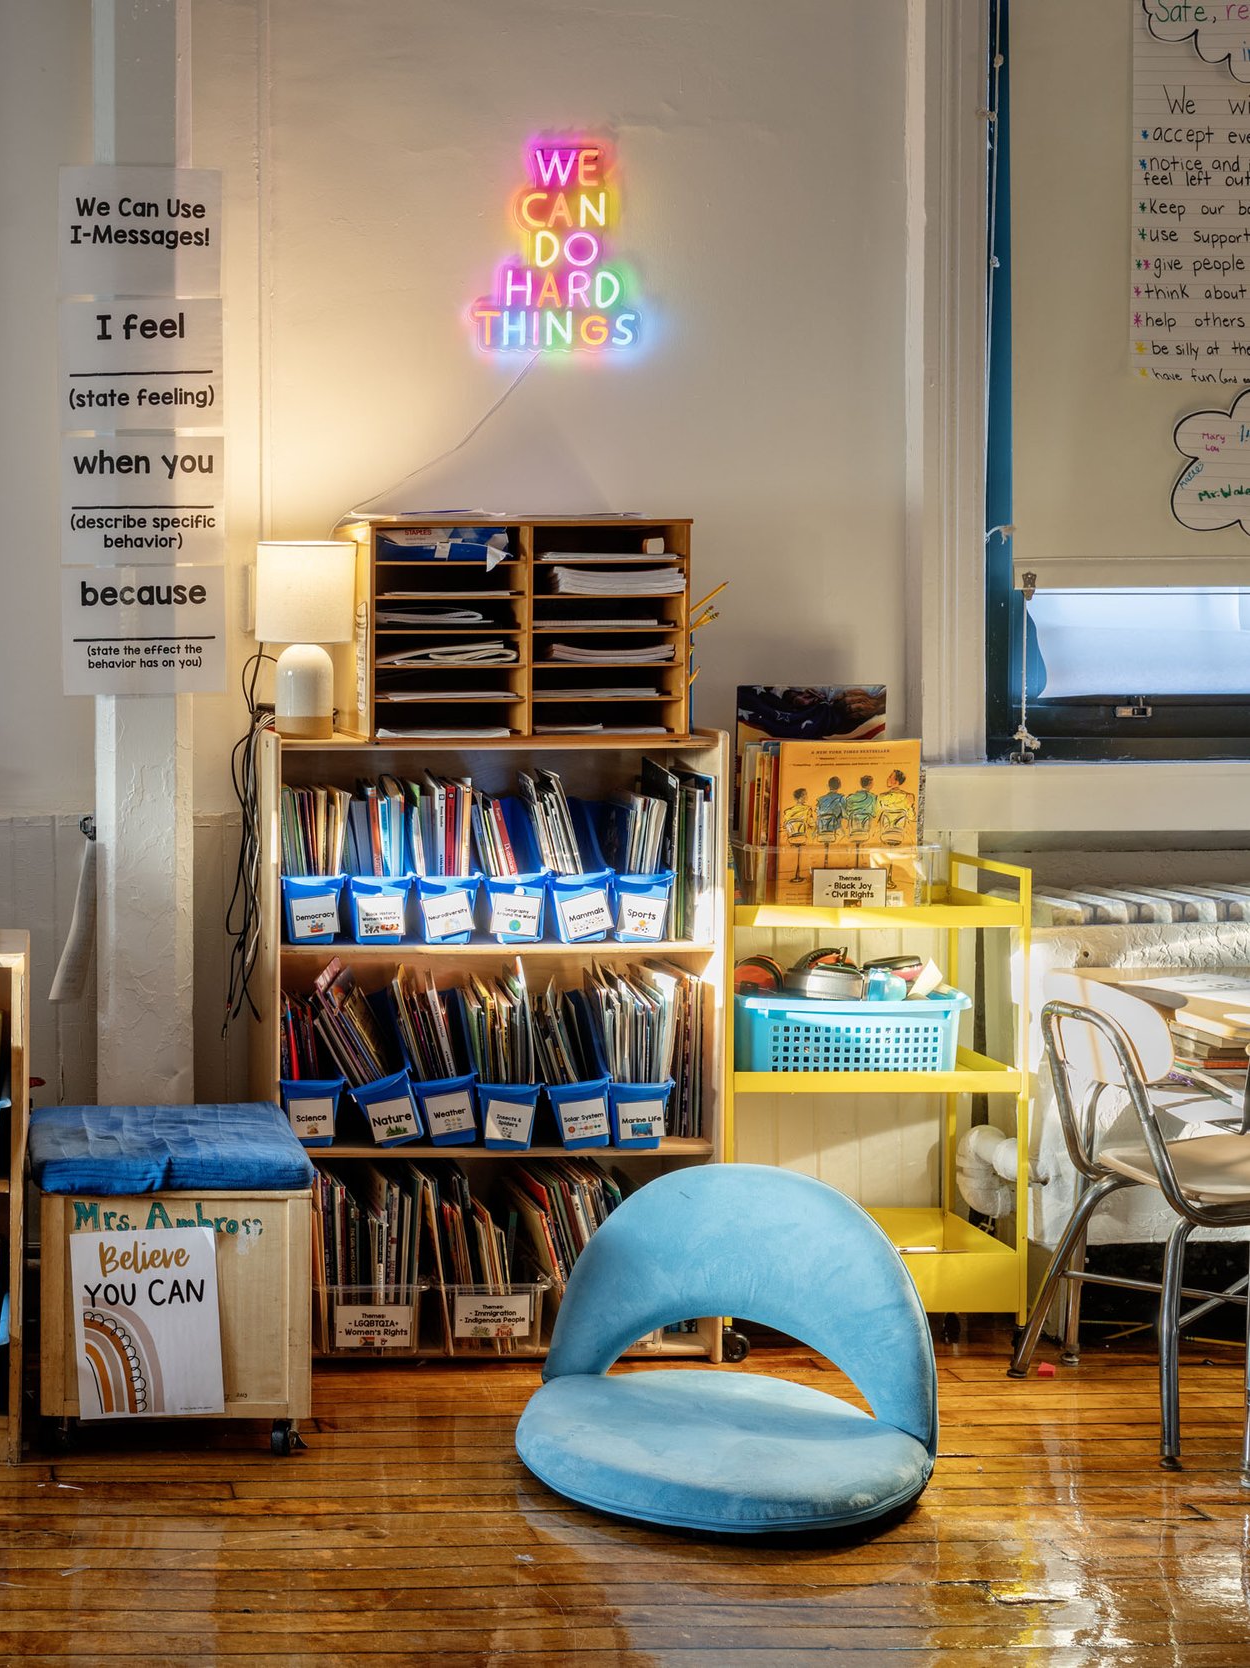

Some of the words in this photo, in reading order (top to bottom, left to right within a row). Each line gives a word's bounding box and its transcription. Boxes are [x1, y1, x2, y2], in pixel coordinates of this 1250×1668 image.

[1163, 84, 1196, 115] We
[1153, 125, 1214, 152] accept
[535, 149, 599, 186] WE
[1150, 155, 1203, 171] notice
[1211, 155, 1240, 172] and
[1144, 171, 1173, 186] feel
[1186, 170, 1212, 186] left
[75, 197, 111, 217] We
[118, 197, 159, 218] Can
[166, 199, 206, 219] Use
[521, 192, 606, 228] CAN
[1201, 204, 1225, 215] our
[70, 224, 210, 250] I-Messages!
[1150, 229, 1179, 242] use
[535, 230, 599, 268] DO
[1154, 258, 1183, 278] give
[1193, 253, 1245, 277] people
[506, 269, 620, 308] HARD
[1144, 283, 1190, 300] think
[1204, 284, 1247, 300] about
[96, 314, 112, 341] I
[122, 312, 185, 340] feel
[474, 311, 636, 346] THINGS
[1145, 312, 1177, 333] help
[1194, 311, 1245, 328] others
[1151, 340, 1169, 355] be
[1175, 342, 1199, 361] silly
[1206, 341, 1220, 355] at
[1151, 367, 1182, 381] have
[1191, 368, 1216, 383] fun
[68, 388, 130, 410] (state
[137, 384, 215, 408] feeling)
[73, 449, 151, 475] when
[161, 453, 214, 480] you
[70, 513, 147, 532] (describe
[152, 514, 216, 532] specific
[103, 533, 183, 550] behavior)
[80, 580, 207, 607] because
[86, 645, 120, 657] (state
[123, 645, 141, 656] the
[144, 644, 181, 656] effect
[184, 644, 203, 655] the
[88, 658, 136, 670] behavior
[140, 658, 159, 669] has
[162, 659, 175, 668] on
[178, 656, 202, 669] you)
[859, 882, 872, 890] Joy
[851, 891, 874, 899] Rights
[296, 911, 335, 921] Democracy
[428, 908, 468, 920] Neurodiversity
[569, 907, 605, 922] Mammals
[627, 908, 656, 920] Sports
[296, 1114, 327, 1122] Science
[372, 1113, 412, 1127] Nature
[433, 1107, 466, 1119] Weather
[564, 1115, 579, 1123] Solar
[581, 1112, 604, 1121] System
[622, 1116, 646, 1124] Marine
[73, 1201, 137, 1232] Mrs.
[99, 1240, 191, 1278] Believe
[83, 1282, 137, 1309] YOU
[148, 1278, 205, 1306] CAN
[475, 1310, 516, 1318] Immigration
[384, 1328, 408, 1337] Rights
